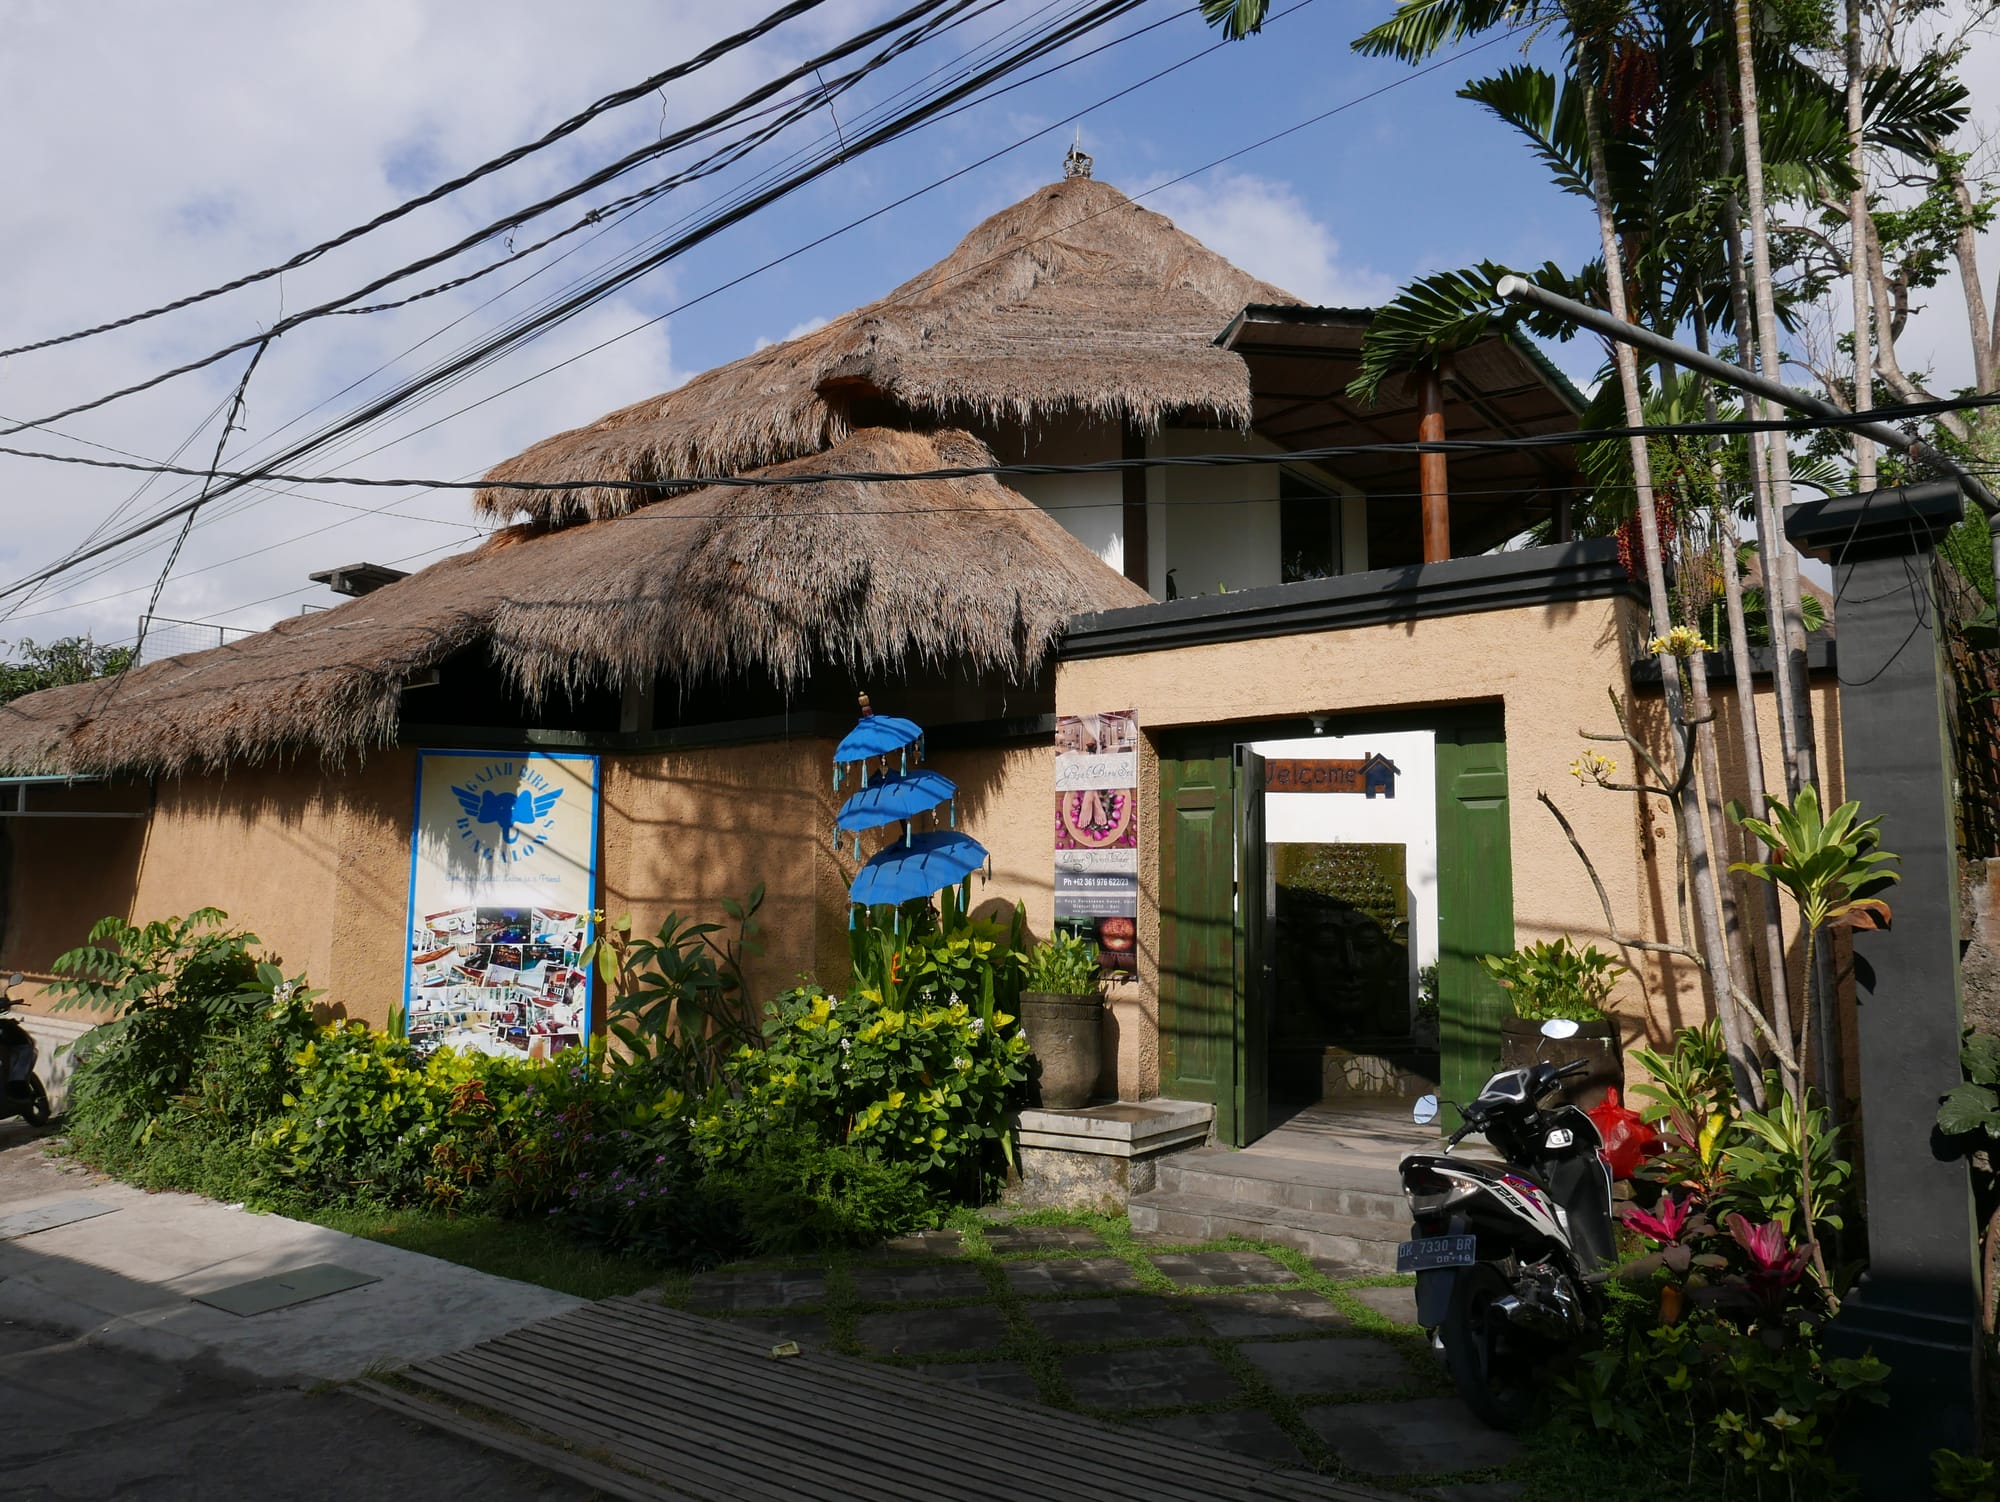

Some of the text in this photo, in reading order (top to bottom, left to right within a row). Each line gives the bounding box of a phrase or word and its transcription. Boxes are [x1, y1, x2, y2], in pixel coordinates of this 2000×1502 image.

[466, 762, 513, 792] GAJAH
[1063, 878, 1072, 886] Ph
[1073, 878, 1084, 886] +62
[1084, 878, 1096, 886] 361
[1399, 1238, 1472, 1258] DK 7330 BR
